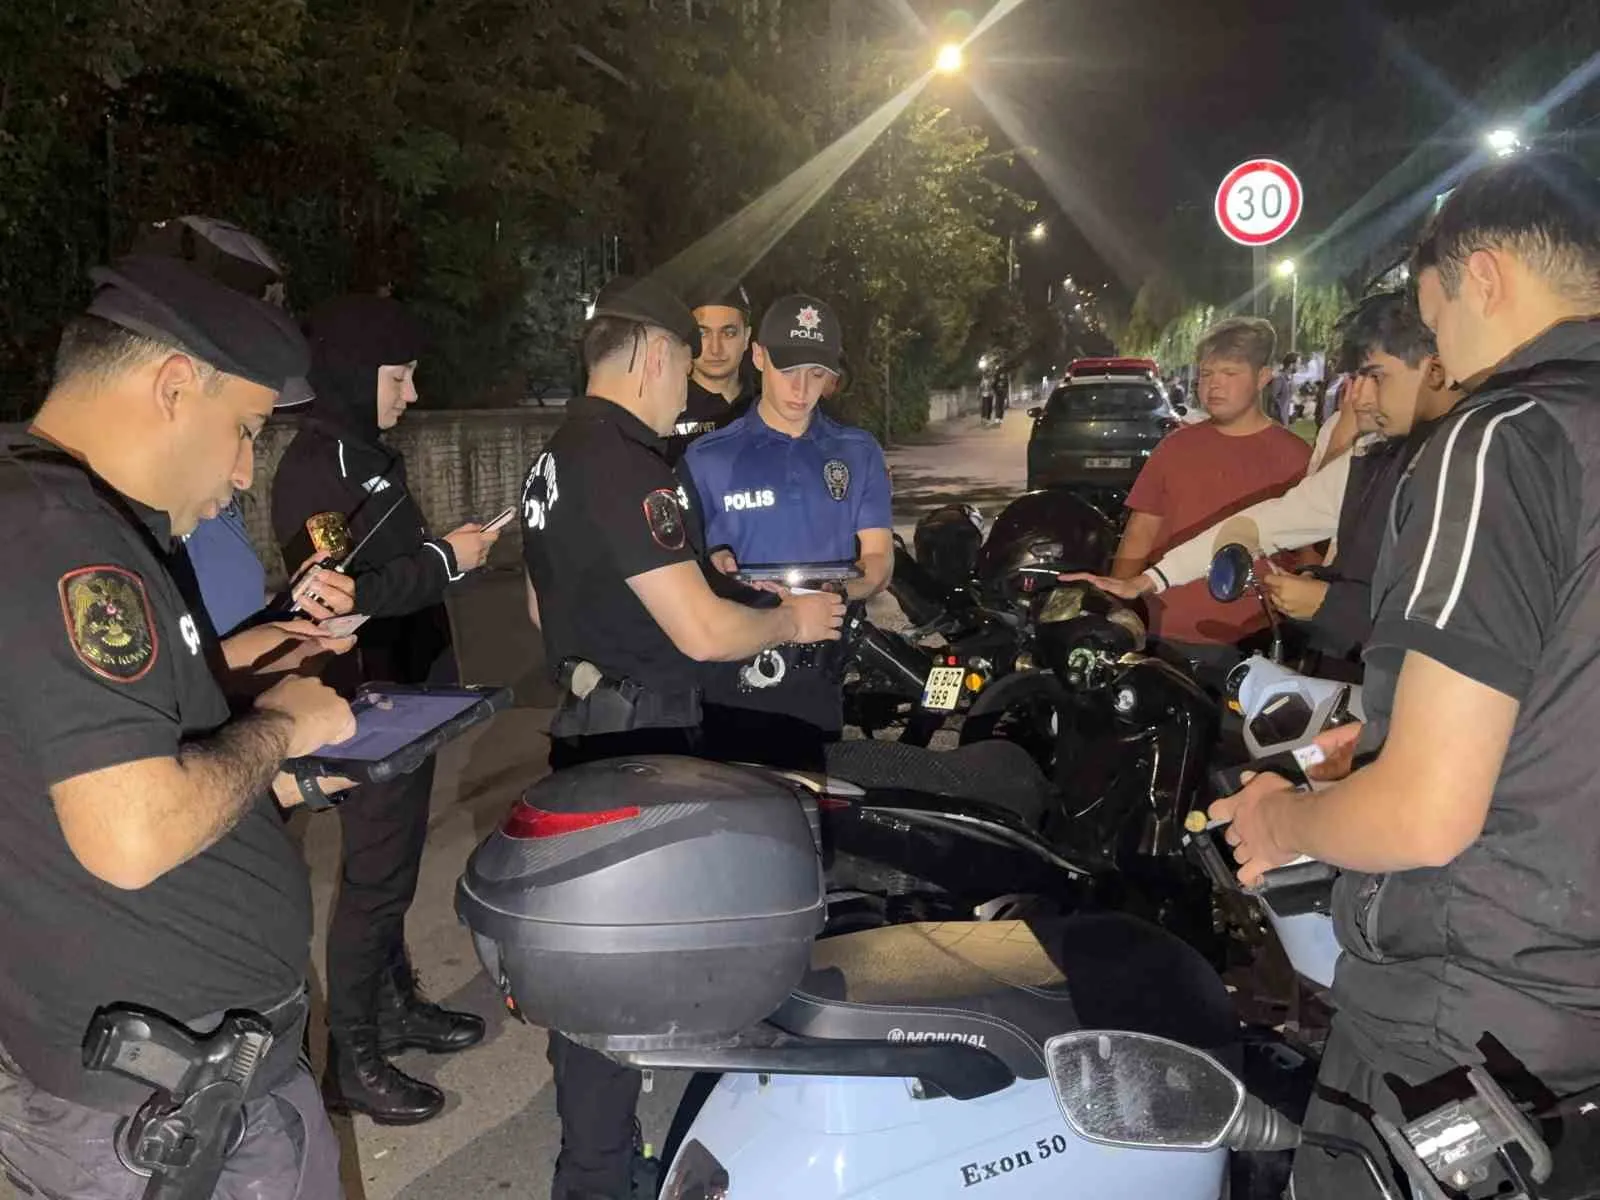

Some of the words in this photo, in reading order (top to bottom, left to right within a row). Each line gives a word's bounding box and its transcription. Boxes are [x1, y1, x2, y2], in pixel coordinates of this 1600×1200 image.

[1236, 184, 1282, 221] 30
[929, 670, 942, 686] 16
[906, 1031, 987, 1048] MONDIAL
[960, 1150, 1033, 1187] Exon
[1035, 1134, 1067, 1160] 50
